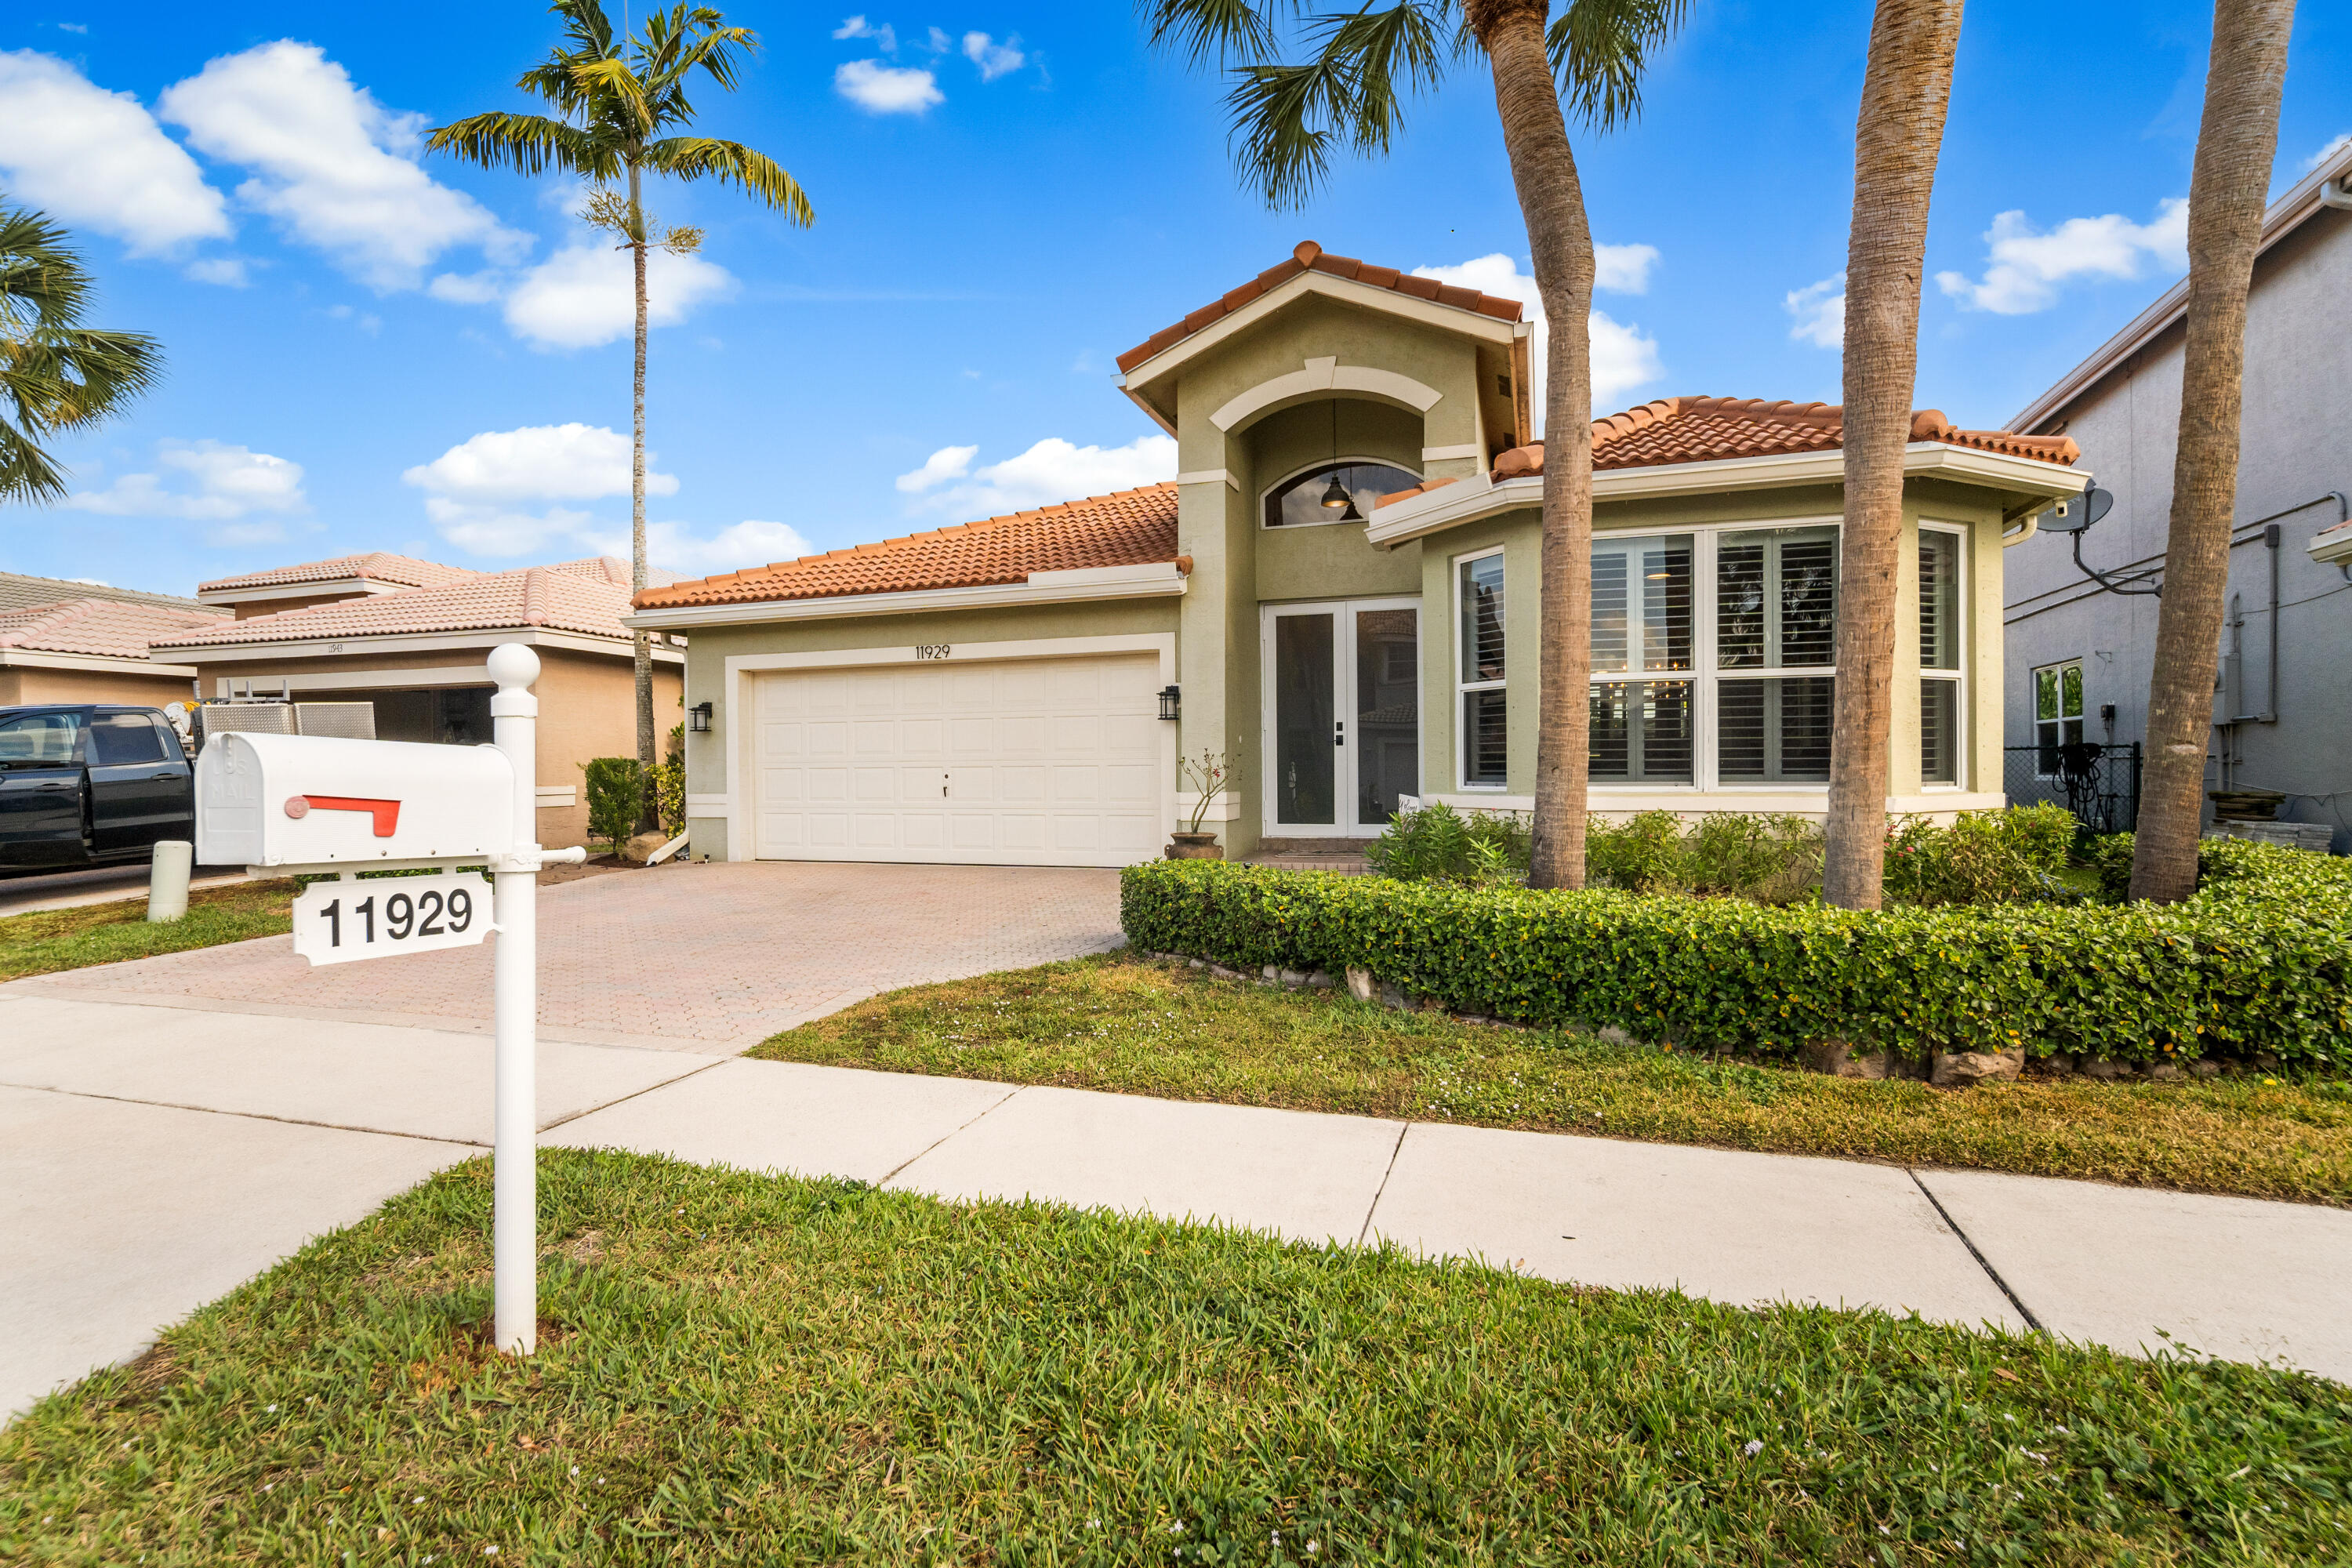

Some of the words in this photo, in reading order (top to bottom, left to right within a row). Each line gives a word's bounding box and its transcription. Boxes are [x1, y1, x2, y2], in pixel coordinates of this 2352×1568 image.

[328, 644, 343, 653] 11943
[915, 644, 950, 659] 11929
[211, 783, 256, 801] MAIL
[320, 888, 472, 947] 11929
